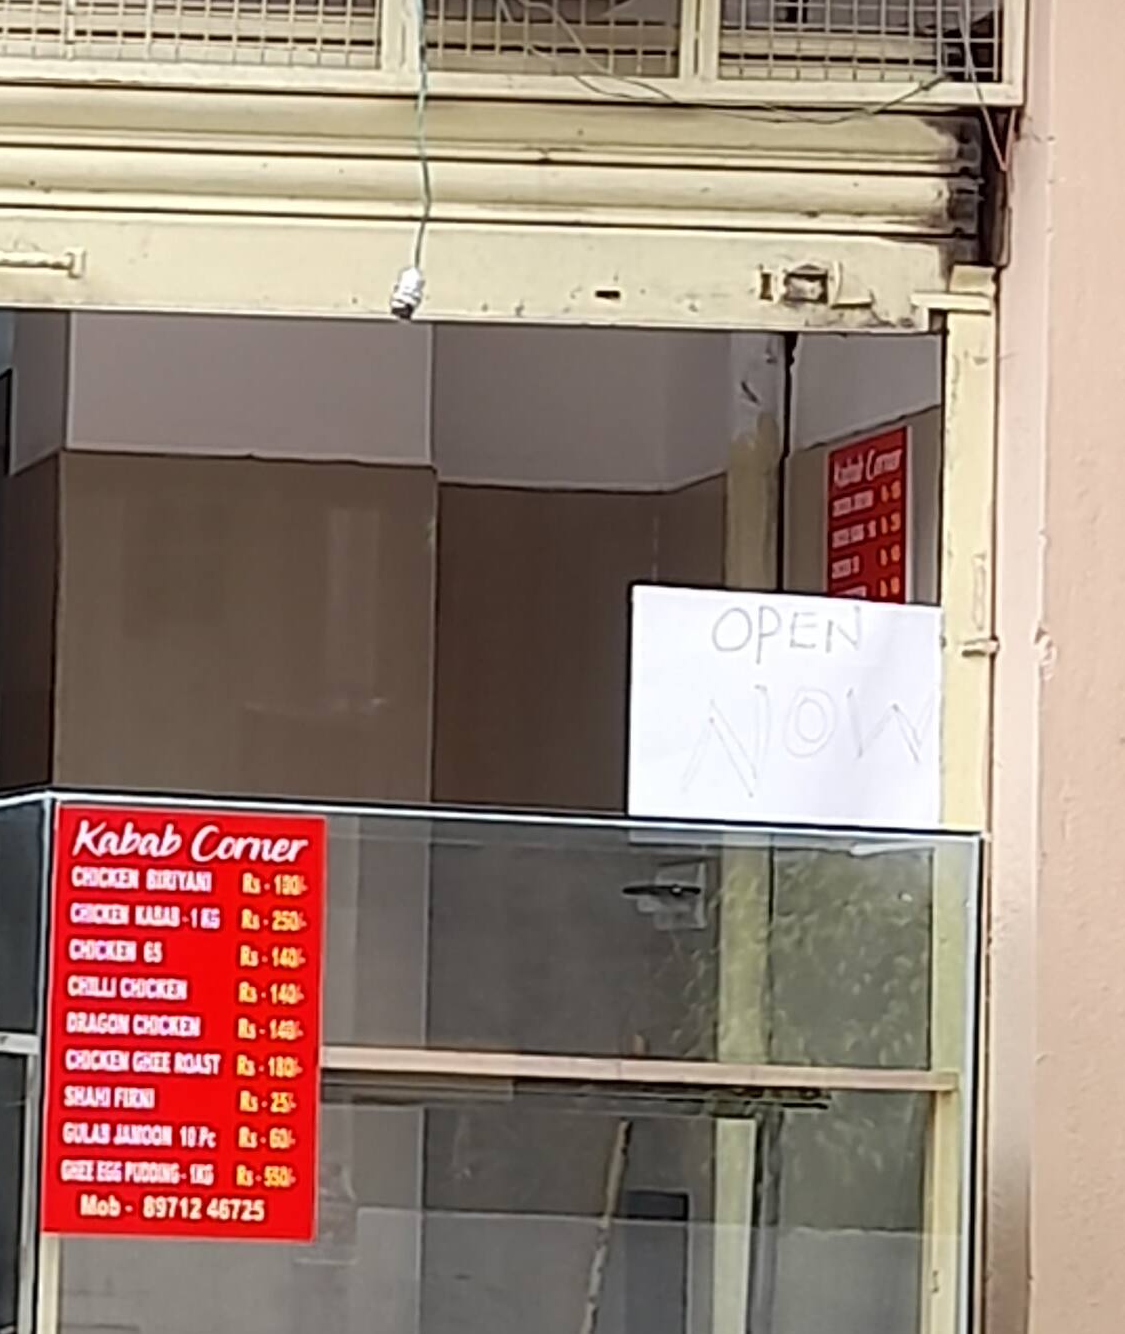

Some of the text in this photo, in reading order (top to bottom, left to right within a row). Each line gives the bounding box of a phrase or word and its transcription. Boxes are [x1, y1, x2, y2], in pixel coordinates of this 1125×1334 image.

[711, 605, 861, 665] OPEN
[73, 820, 308, 862] Kabab Corner
[71, 865, 140, 889] CHICKEN
[242, 872, 262, 895] Rs
[70, 902, 130, 925] CHICKEN
[240, 908, 261, 931] Rs
[69, 938, 137, 962] CHICKEN
[239, 944, 259, 967] Rs
[67, 975, 117, 998] CHILLI
[119, 977, 188, 1001] CHICKEN
[238, 981, 258, 1004] Rs
[66, 1011, 130, 1035] DRAGON
[132, 1014, 201, 1037] CHICKEN
[237, 1017, 257, 1040] Rs
[65, 1049, 130, 1072] CHICKEN
[173, 1052, 221, 1075] ROAST
[236, 1054, 256, 1077] Rs
[64, 1085, 111, 1108] SHAHI
[239, 1090, 259, 1113] Rs
[62, 1121, 111, 1145] GULAB
[238, 1125, 258, 1149] Rs
[236, 1164, 254, 1187] Rs
[80, 1194, 121, 1217] Mob
[143, 1195, 202, 1220] 89712
[206, 1198, 265, 1222] 46725
